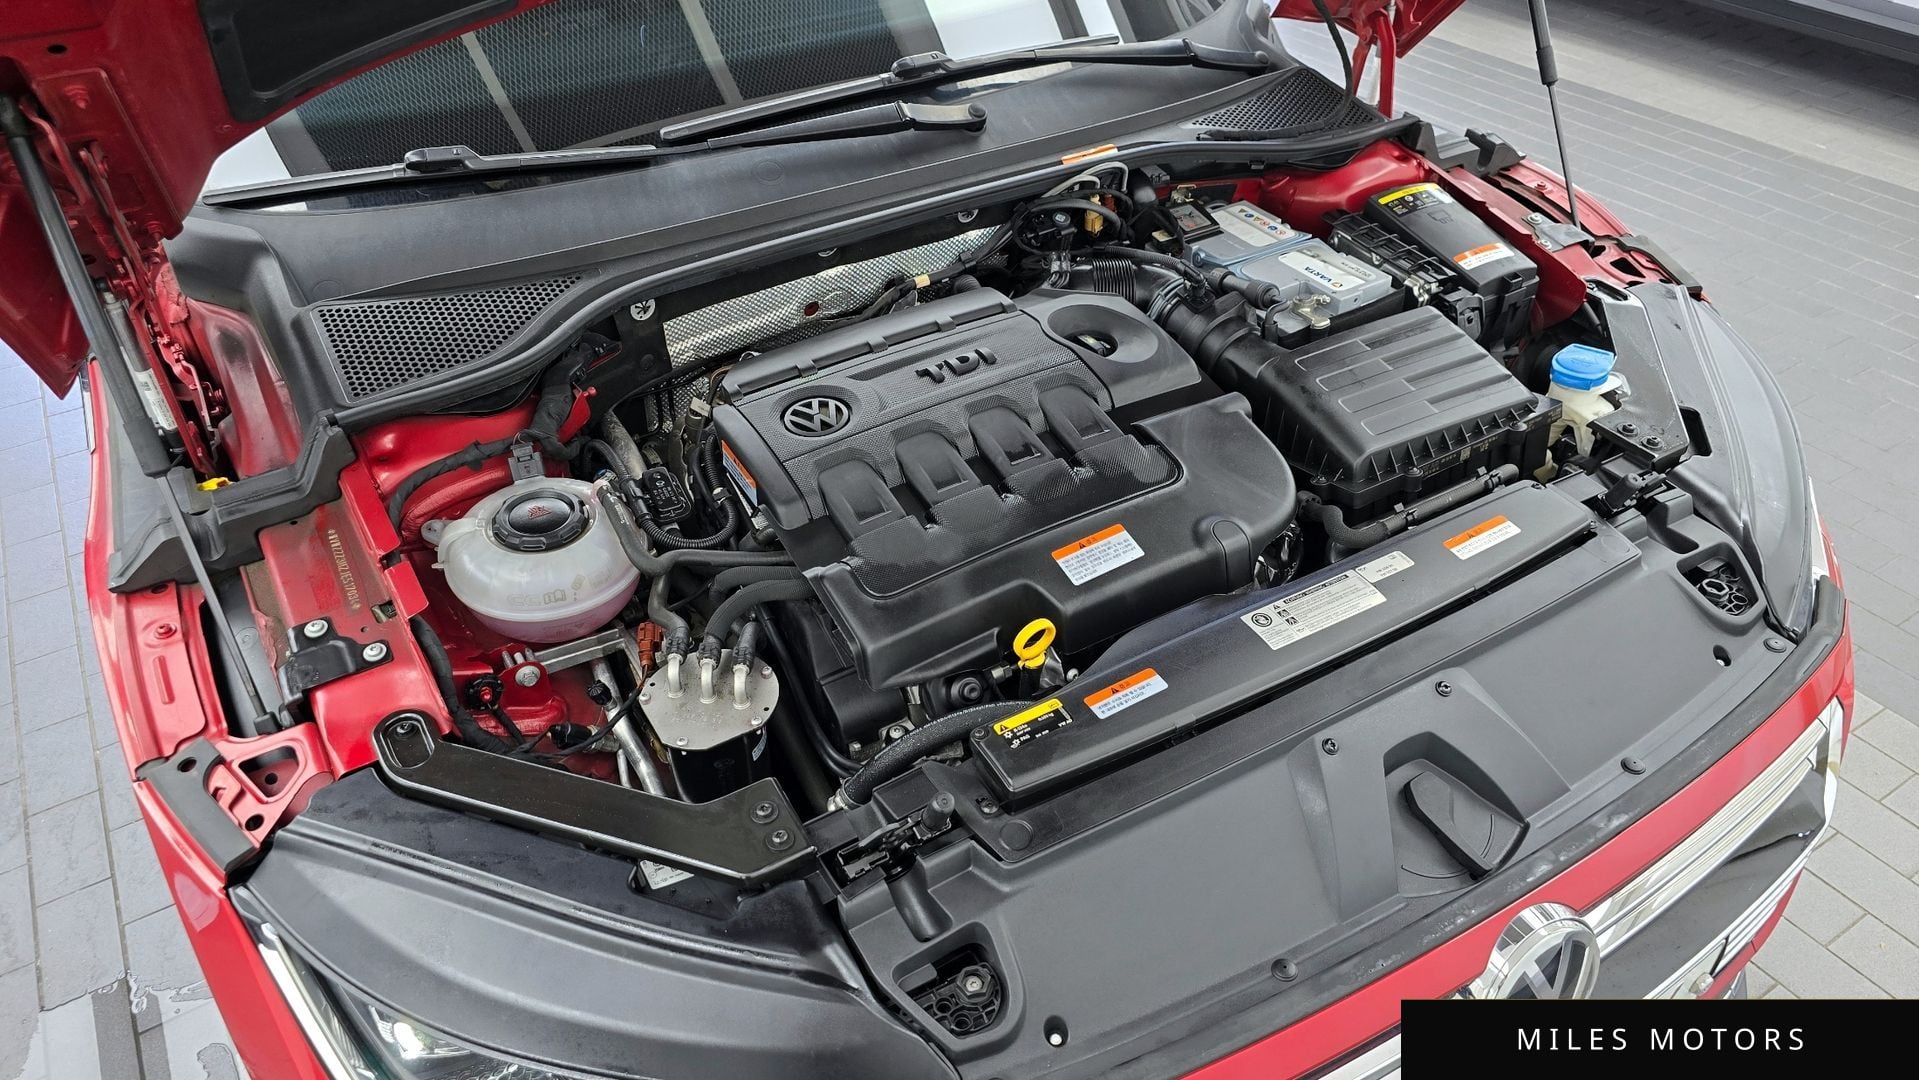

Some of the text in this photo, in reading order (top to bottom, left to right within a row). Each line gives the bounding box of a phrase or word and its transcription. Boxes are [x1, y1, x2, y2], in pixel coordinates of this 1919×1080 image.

[1304, 266, 1332, 283] VARTA
[915, 348, 997, 384] TDI
[783, 397, 850, 437] VW
